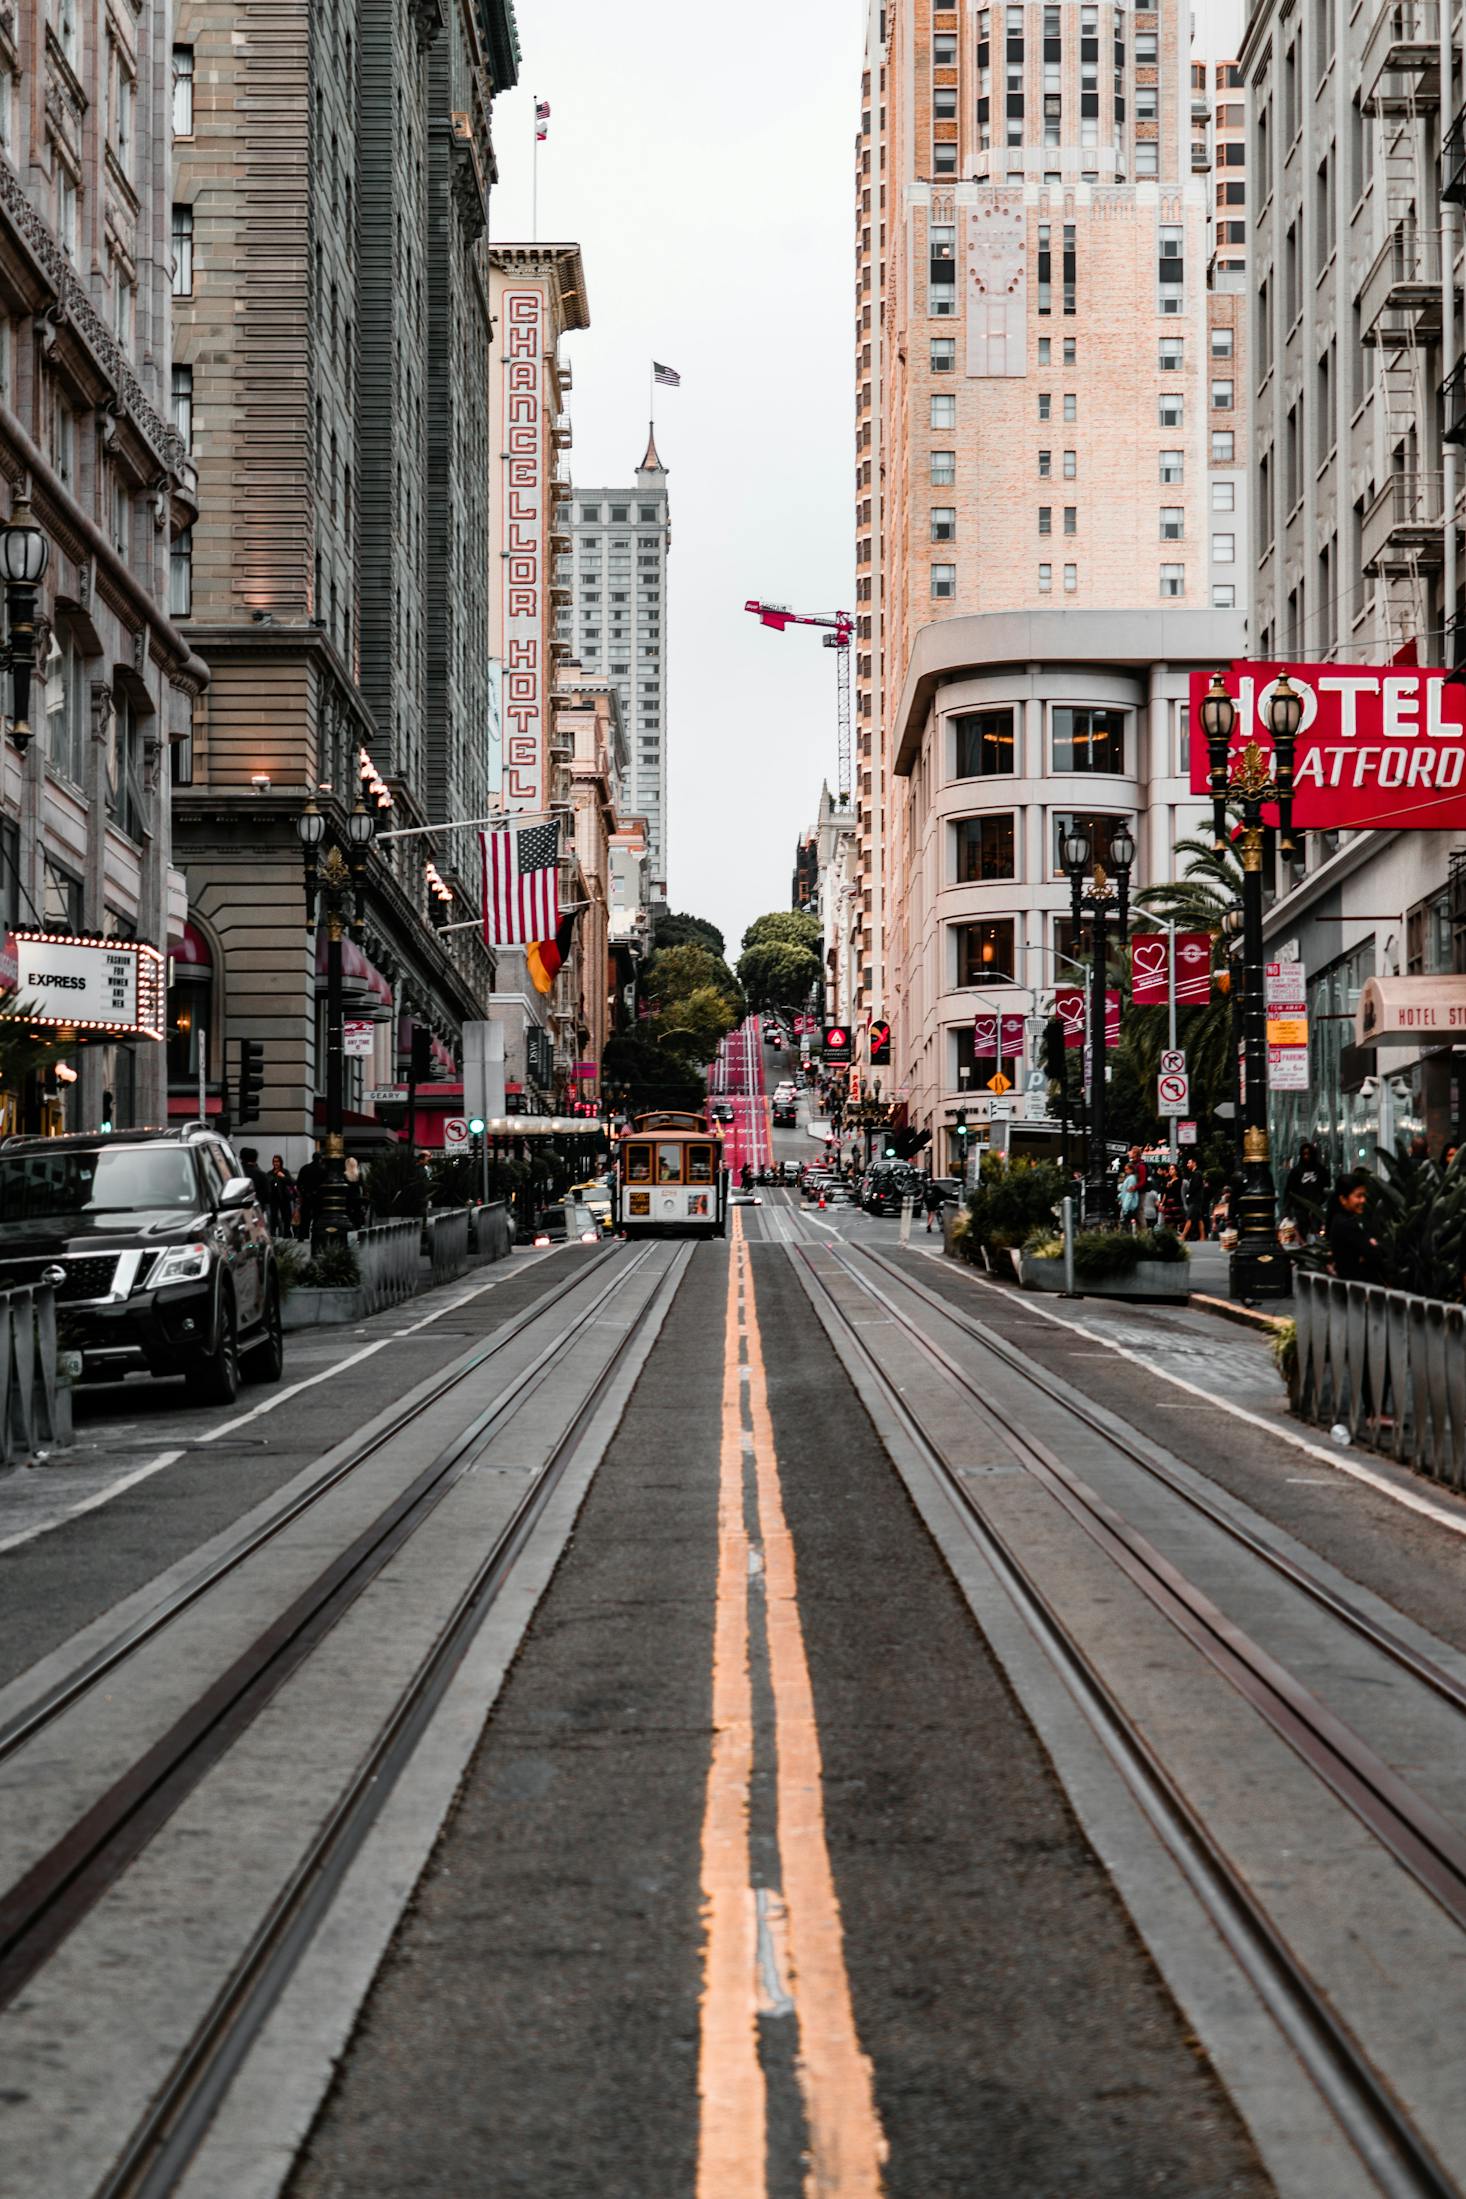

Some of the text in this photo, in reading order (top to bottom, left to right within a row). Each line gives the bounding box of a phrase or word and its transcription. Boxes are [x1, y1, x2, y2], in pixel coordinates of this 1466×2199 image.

[507, 296, 538, 797] CHANCELLOR HOTEL
[1208, 676, 1464, 737] HOTEL
[1206, 747, 1466, 788] ATFORD
[106, 955, 131, 966] FASHION
[113, 967, 125, 976] FOR
[1267, 965, 1279, 976] NO
[28, 973, 86, 990] EXPRESS
[107, 978, 129, 987] WOMEN
[112, 988, 125, 997] AND
[111, 999, 125, 1008] MEN
[1398, 1007, 1466, 1026] HOTEL ST
[529, 1040, 538, 1064] DSW
[1281, 1054, 1306, 1062] PARKING
